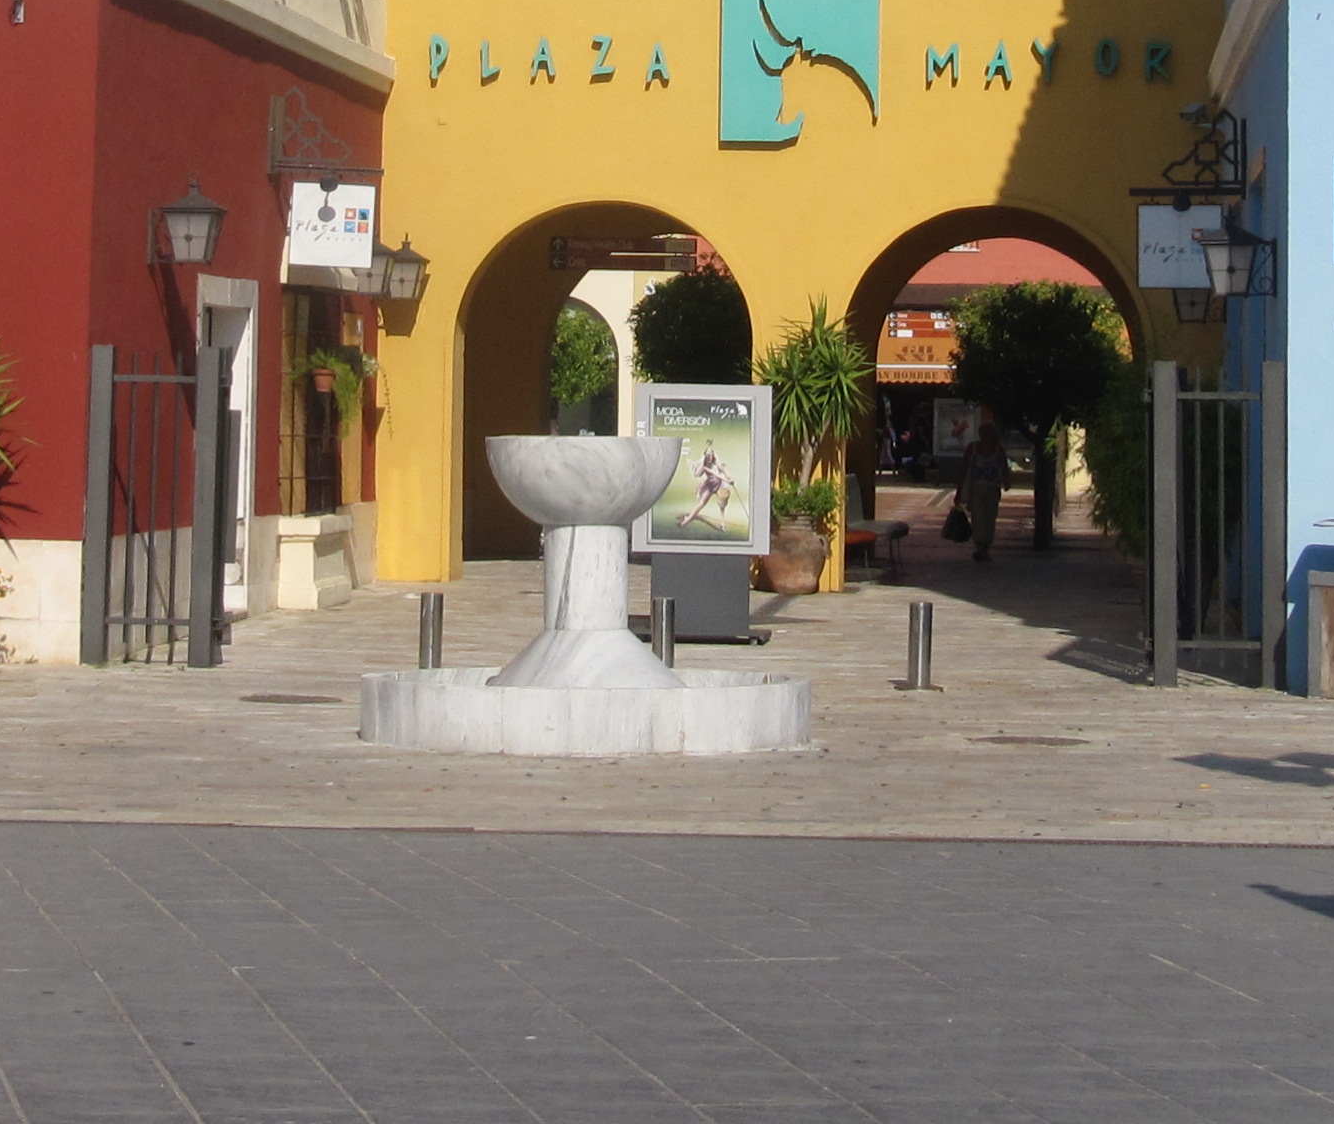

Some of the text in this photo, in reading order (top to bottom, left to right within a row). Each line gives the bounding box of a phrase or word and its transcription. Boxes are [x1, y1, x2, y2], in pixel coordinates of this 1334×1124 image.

[429, 34, 1173, 87] PLAZA MAYOR
[893, 371, 938, 380] HOMBRE
[656, 406, 684, 416] MODA
[664, 416, 710, 426] DIVERSIÓN
